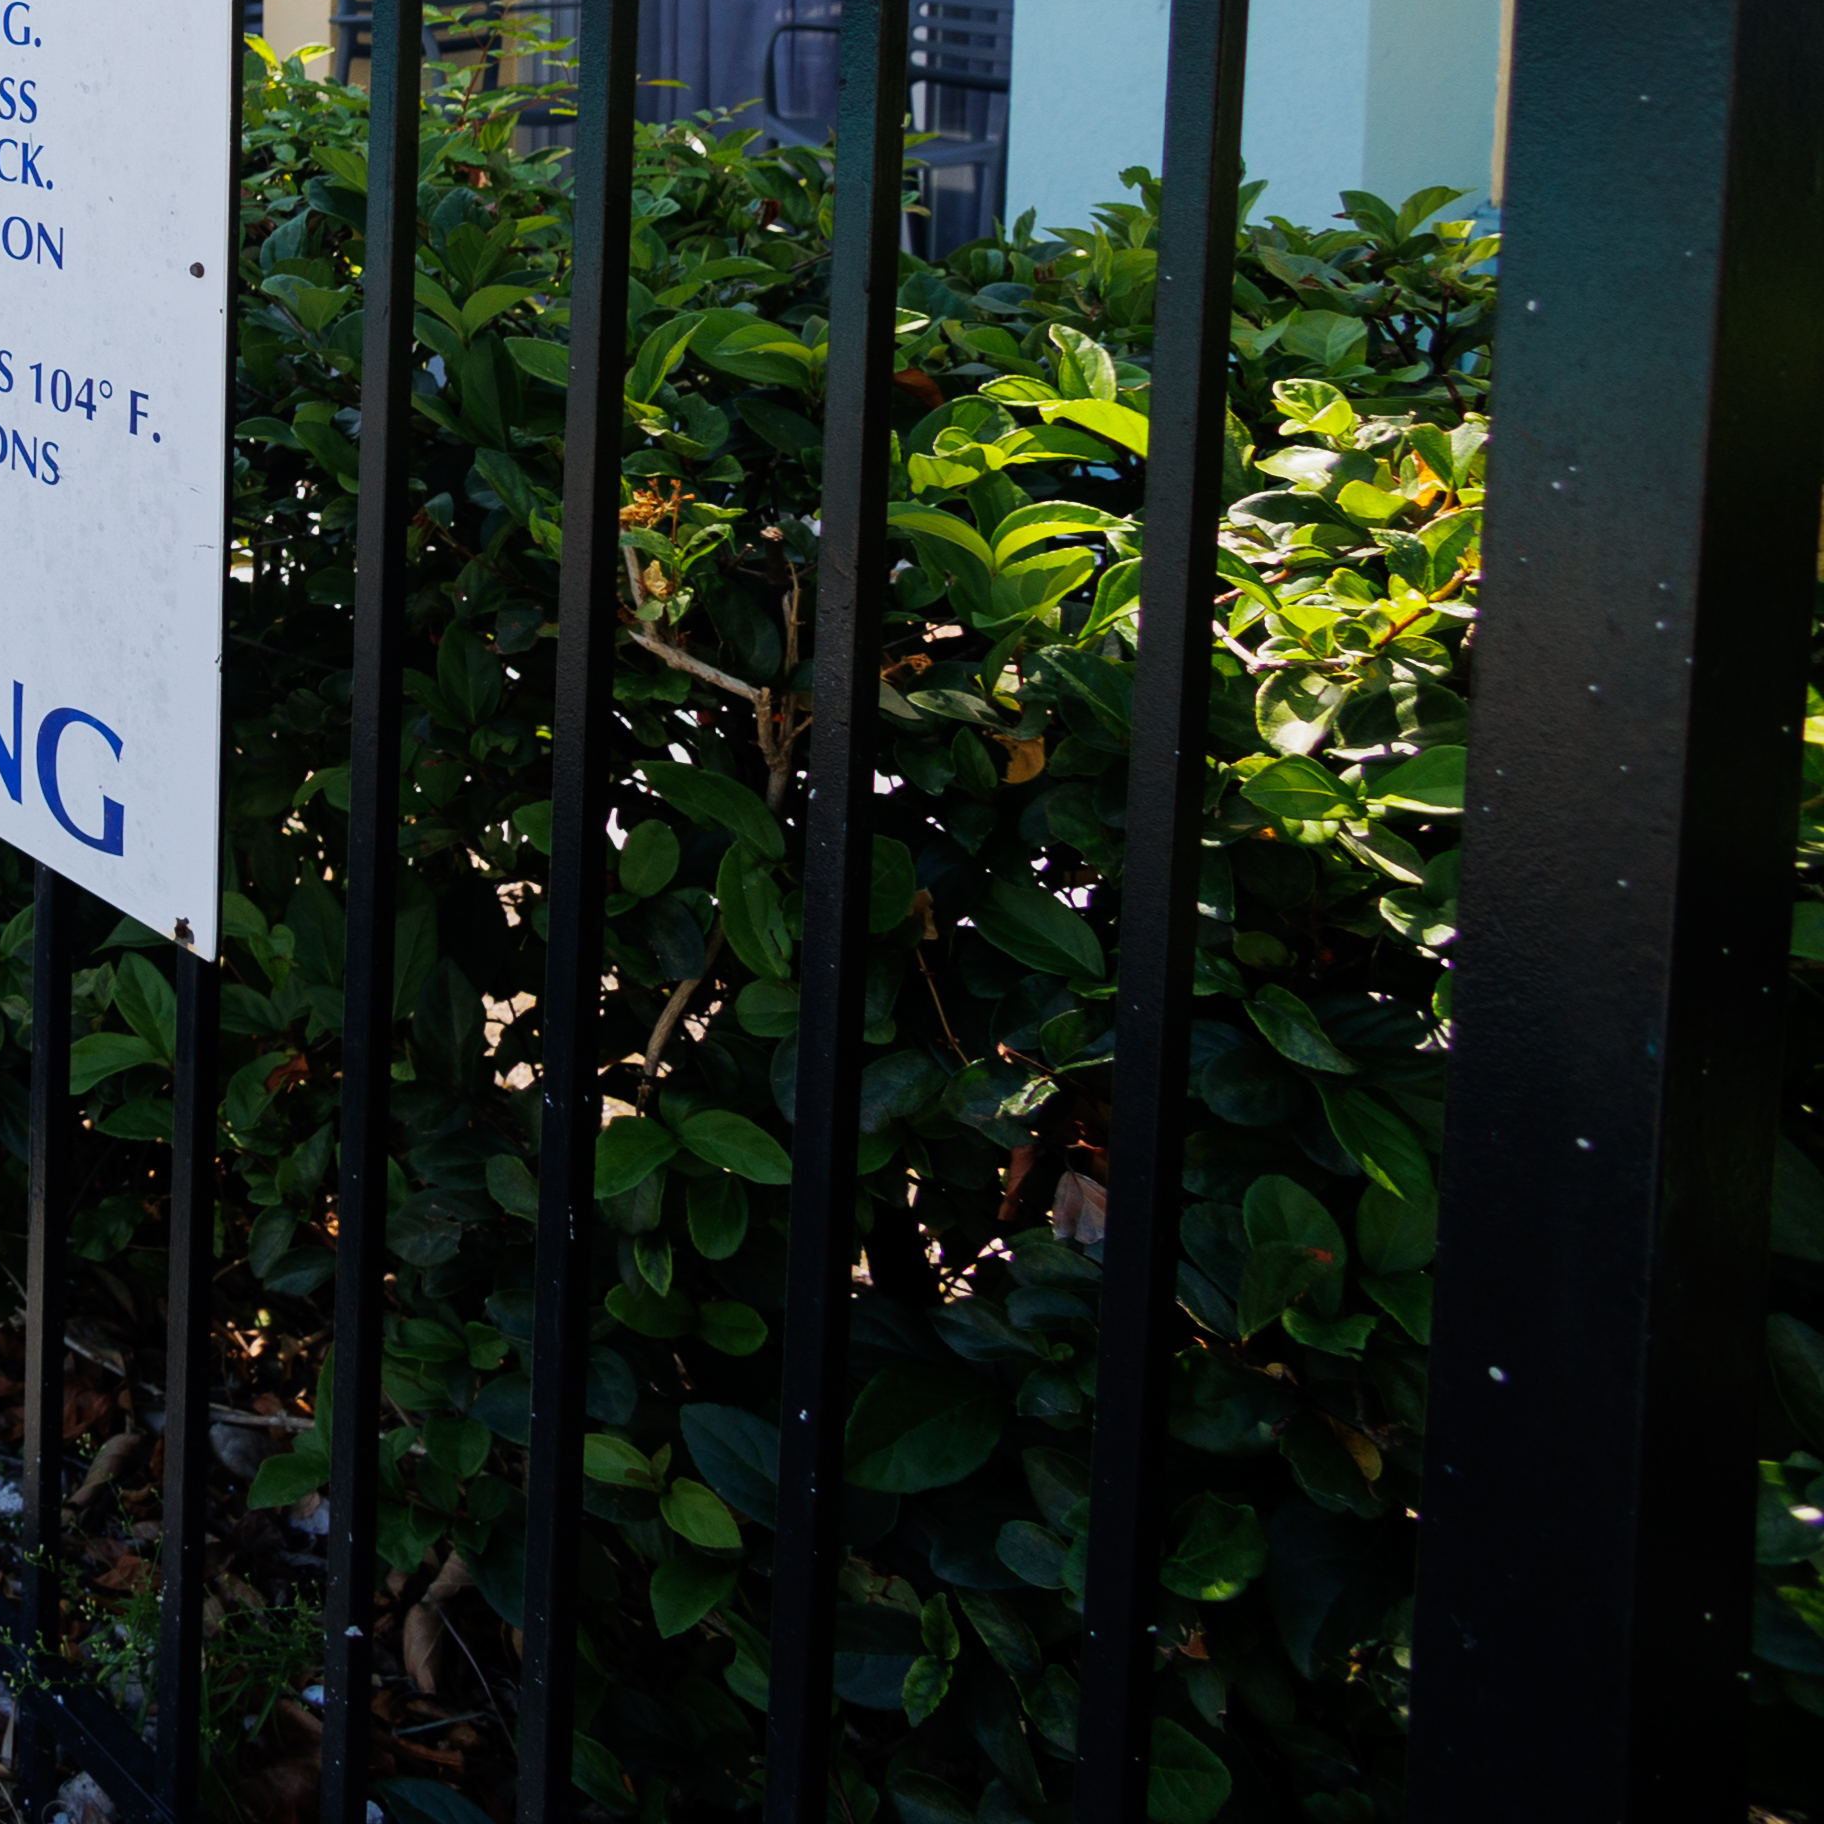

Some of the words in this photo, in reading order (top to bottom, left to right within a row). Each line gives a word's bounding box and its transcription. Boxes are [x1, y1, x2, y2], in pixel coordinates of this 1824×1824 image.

[0, 215, 64, 271] ON
[28, 361, 113, 422] 104°
[128, 389, 161, 444] F.
